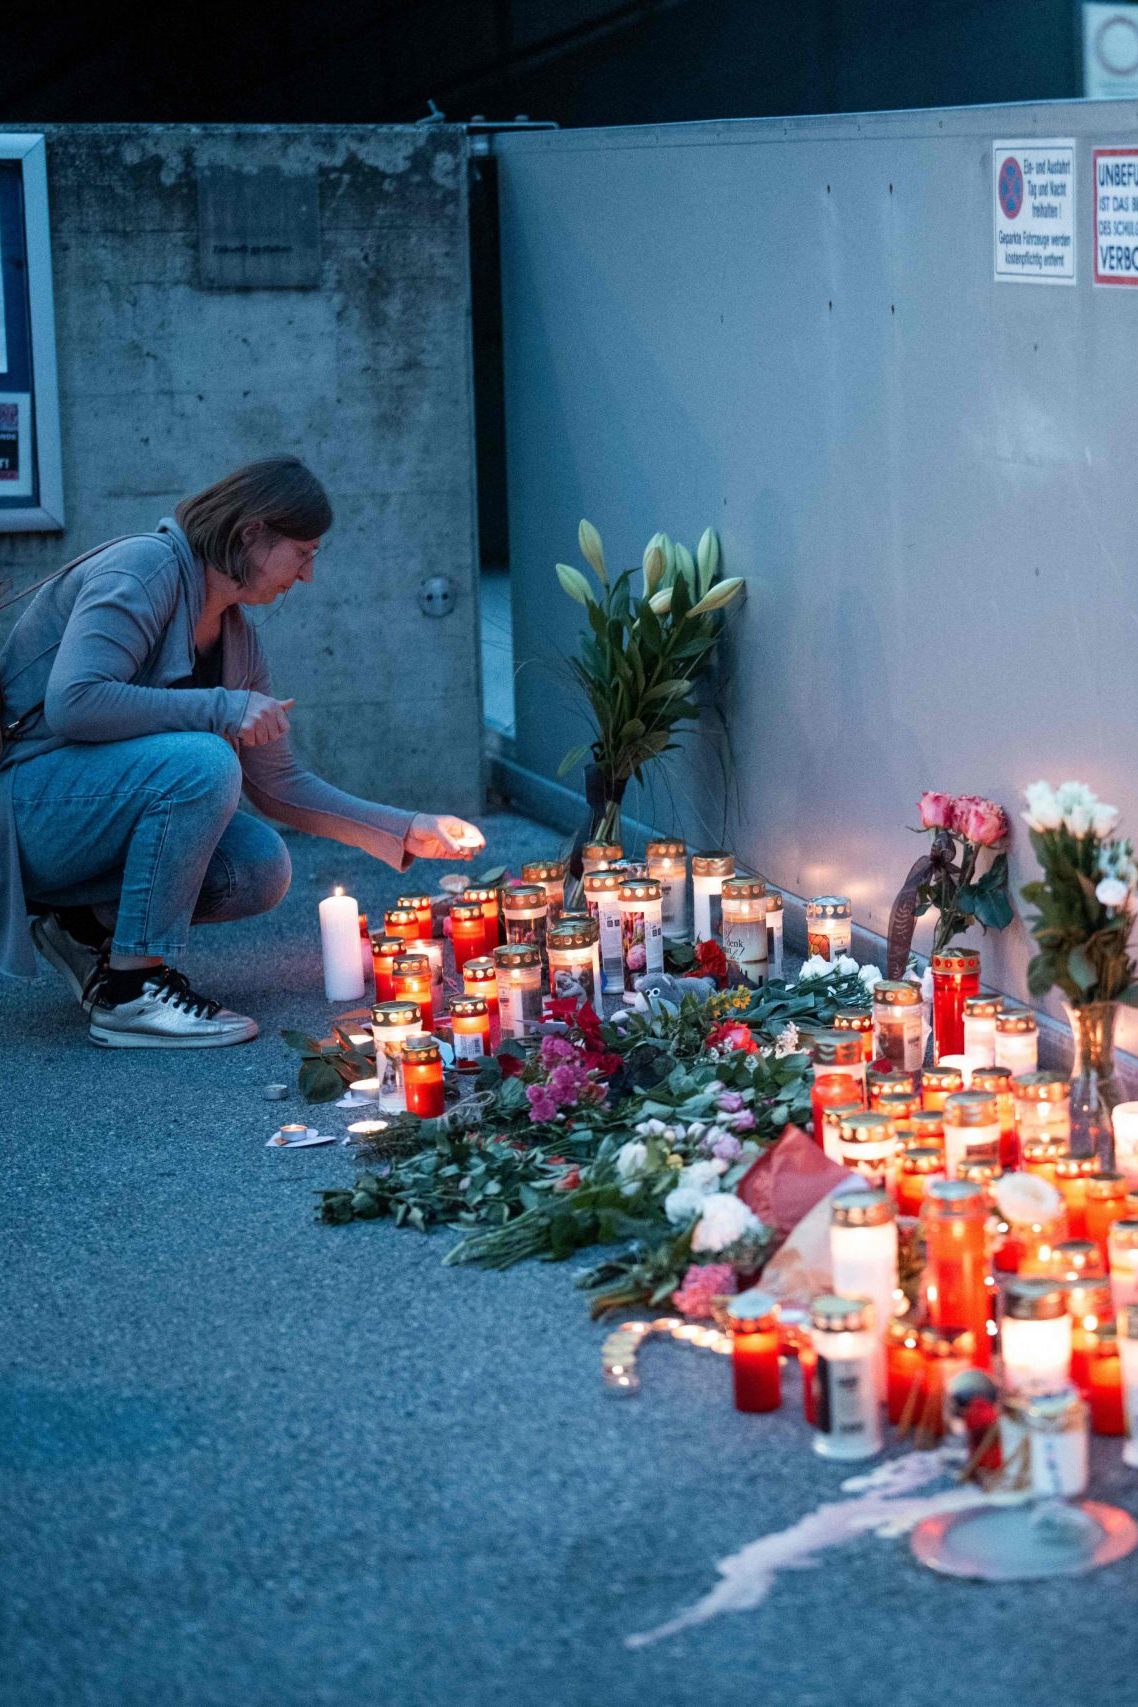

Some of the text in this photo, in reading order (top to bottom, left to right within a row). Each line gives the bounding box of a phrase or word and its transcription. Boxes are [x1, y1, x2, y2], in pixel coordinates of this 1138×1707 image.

[1024, 159, 1071, 176] Ein- und Ausfahrt
[1028, 180, 1067, 200] Tag und Nacht
[1032, 202, 1058, 218] freihalten
[1099, 196, 1110, 211] IST
[1113, 196, 1129, 211] DAS
[1099, 220, 1110, 235] DES
[999, 230, 1071, 250] Geparkte Fahrzeuge werden
[1005, 251, 1064, 269] kostenpflichtig entfernt
